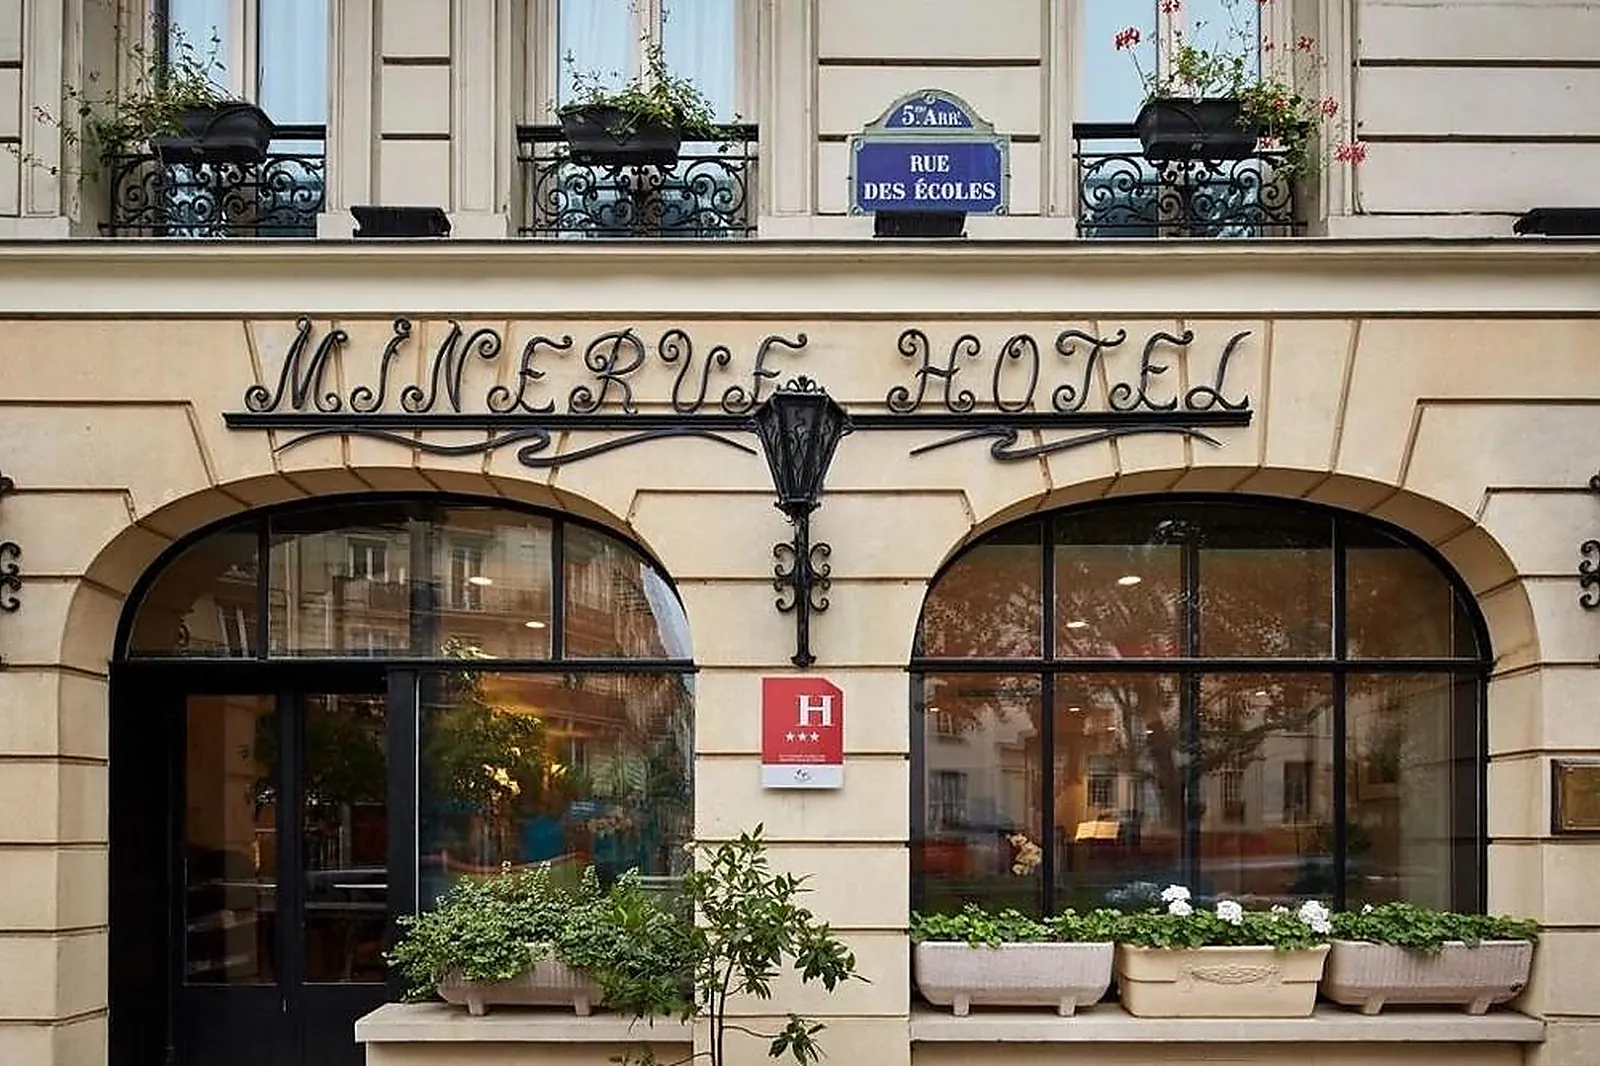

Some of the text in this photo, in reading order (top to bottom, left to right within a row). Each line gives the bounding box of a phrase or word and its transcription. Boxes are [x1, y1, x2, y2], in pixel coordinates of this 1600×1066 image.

[910, 155, 950, 172] RUE
[864, 178, 996, 200] DES ÉCOLES
[244, 317, 1252, 414] MINERVE HOTEL
[795, 694, 836, 727] H
